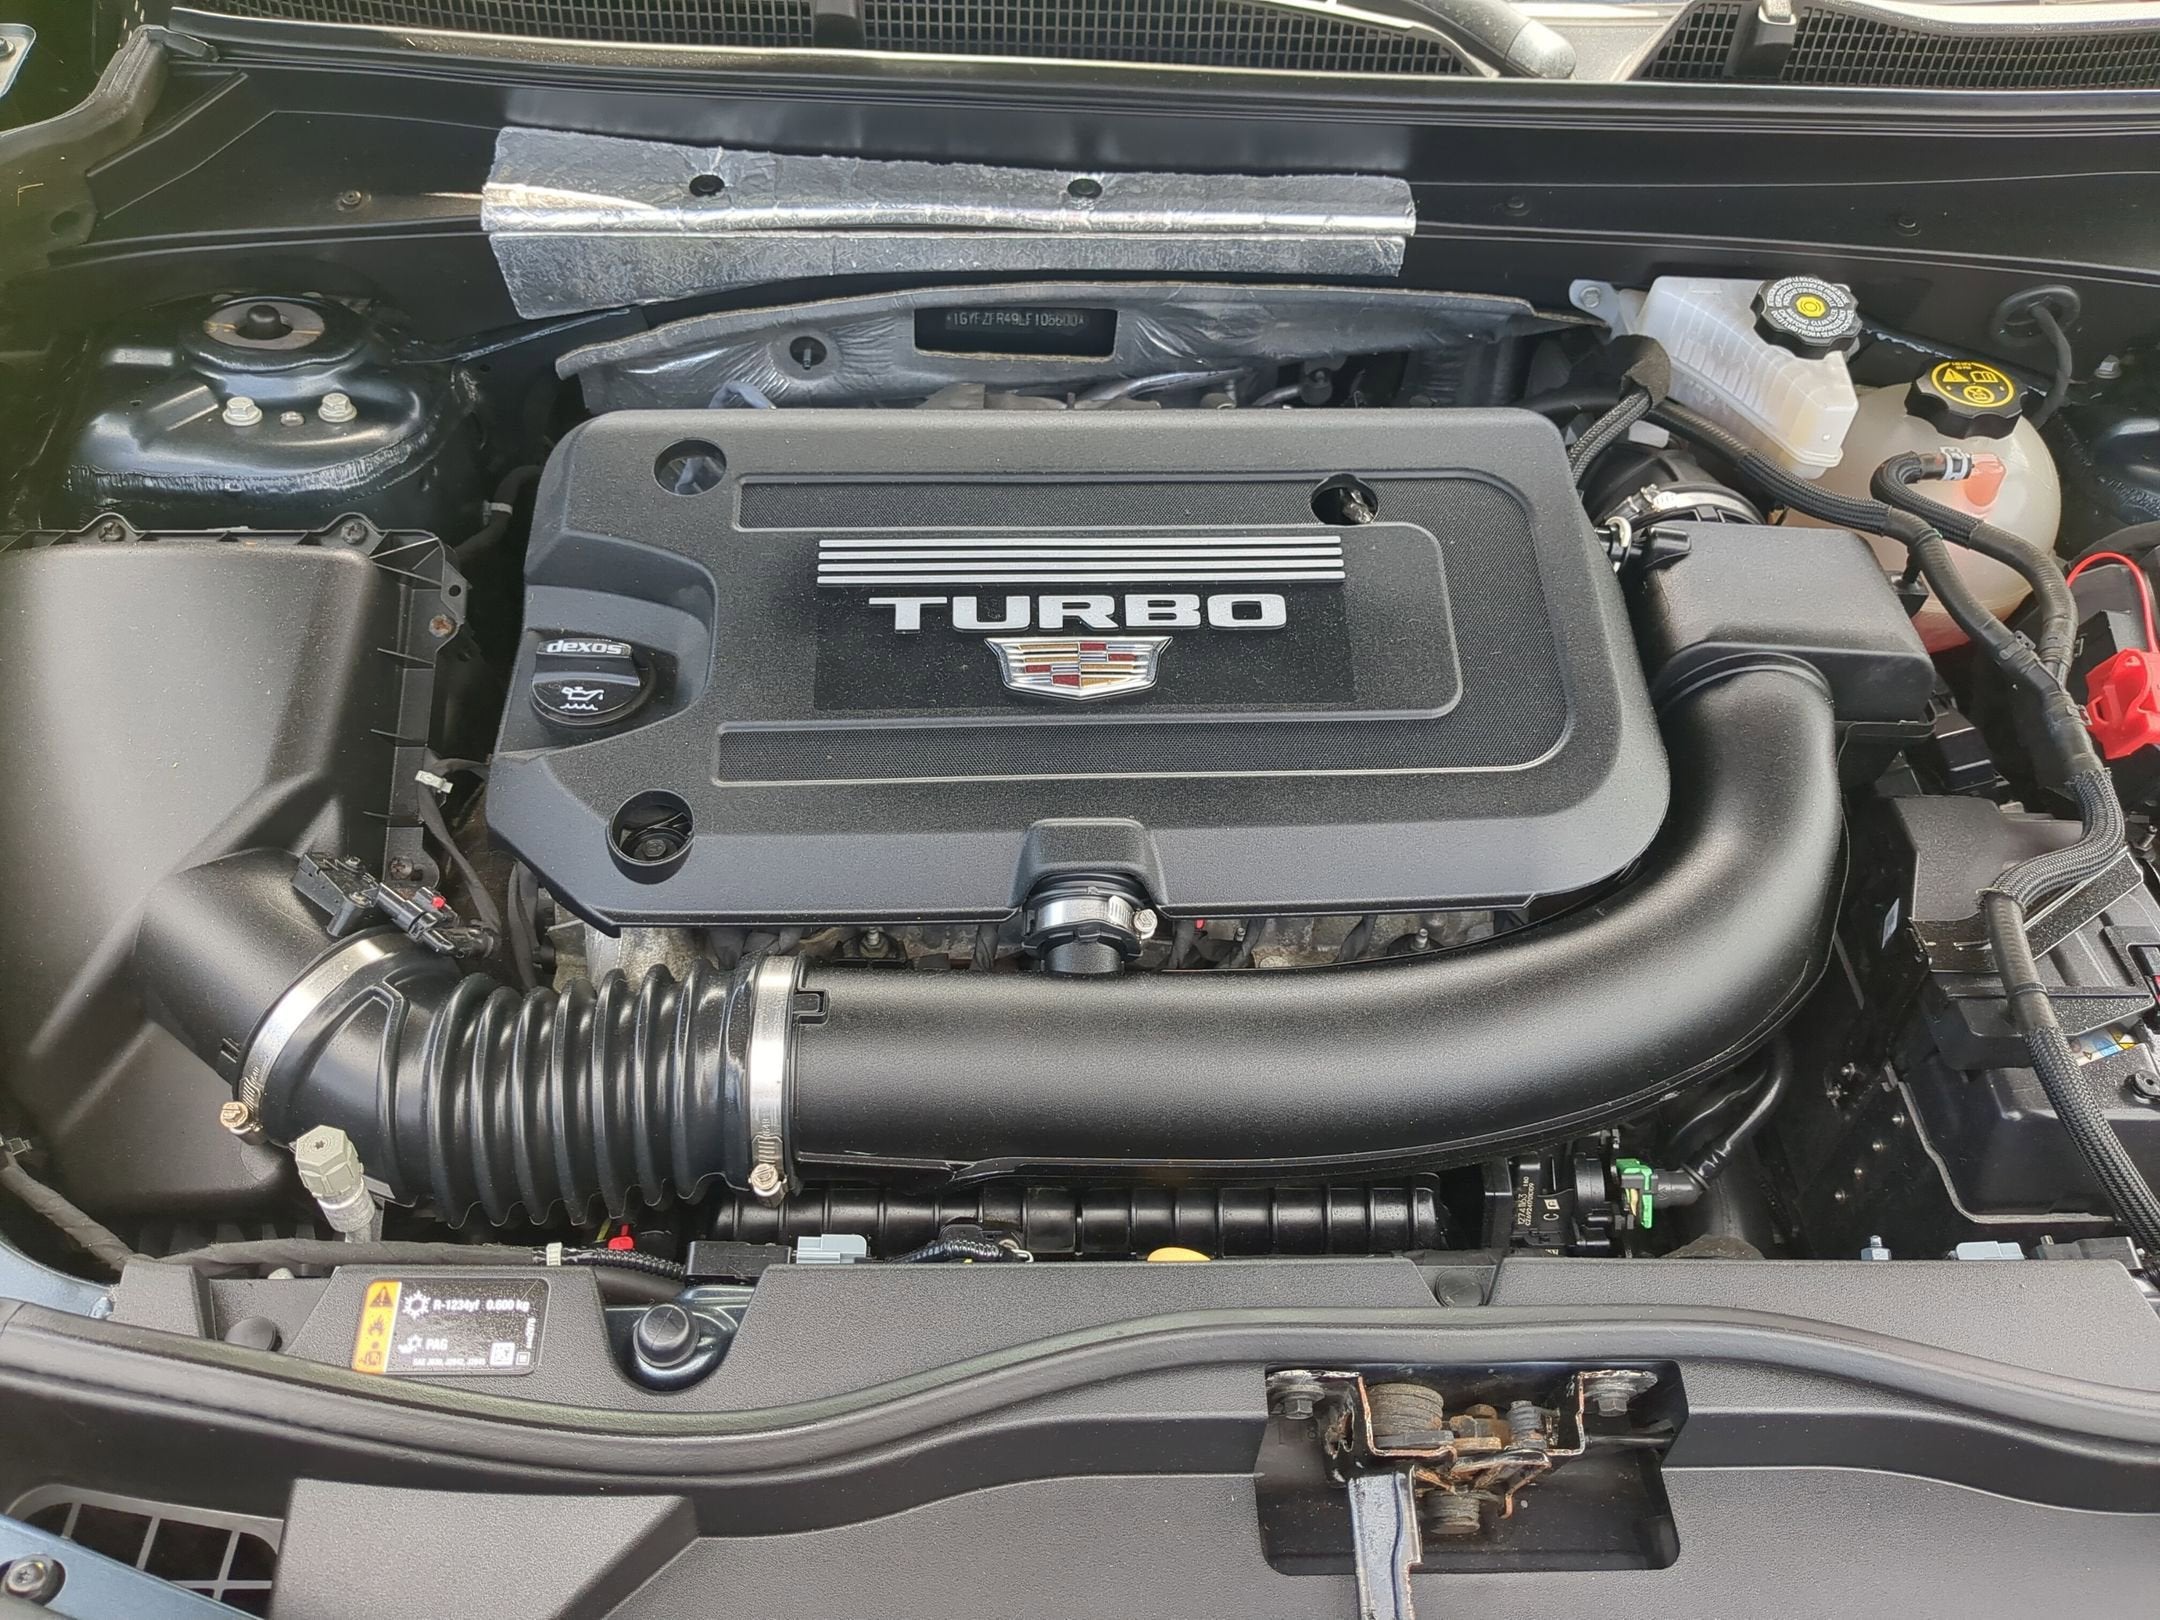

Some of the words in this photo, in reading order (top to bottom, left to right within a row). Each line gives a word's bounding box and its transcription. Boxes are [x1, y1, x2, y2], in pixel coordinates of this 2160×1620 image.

[869, 594, 1286, 633] TURBO
[547, 640, 622, 654] dexos
[433, 1299, 480, 1312] R-1234yf
[515, 1299, 530, 1313] kg
[425, 1338, 449, 1350] PAG
